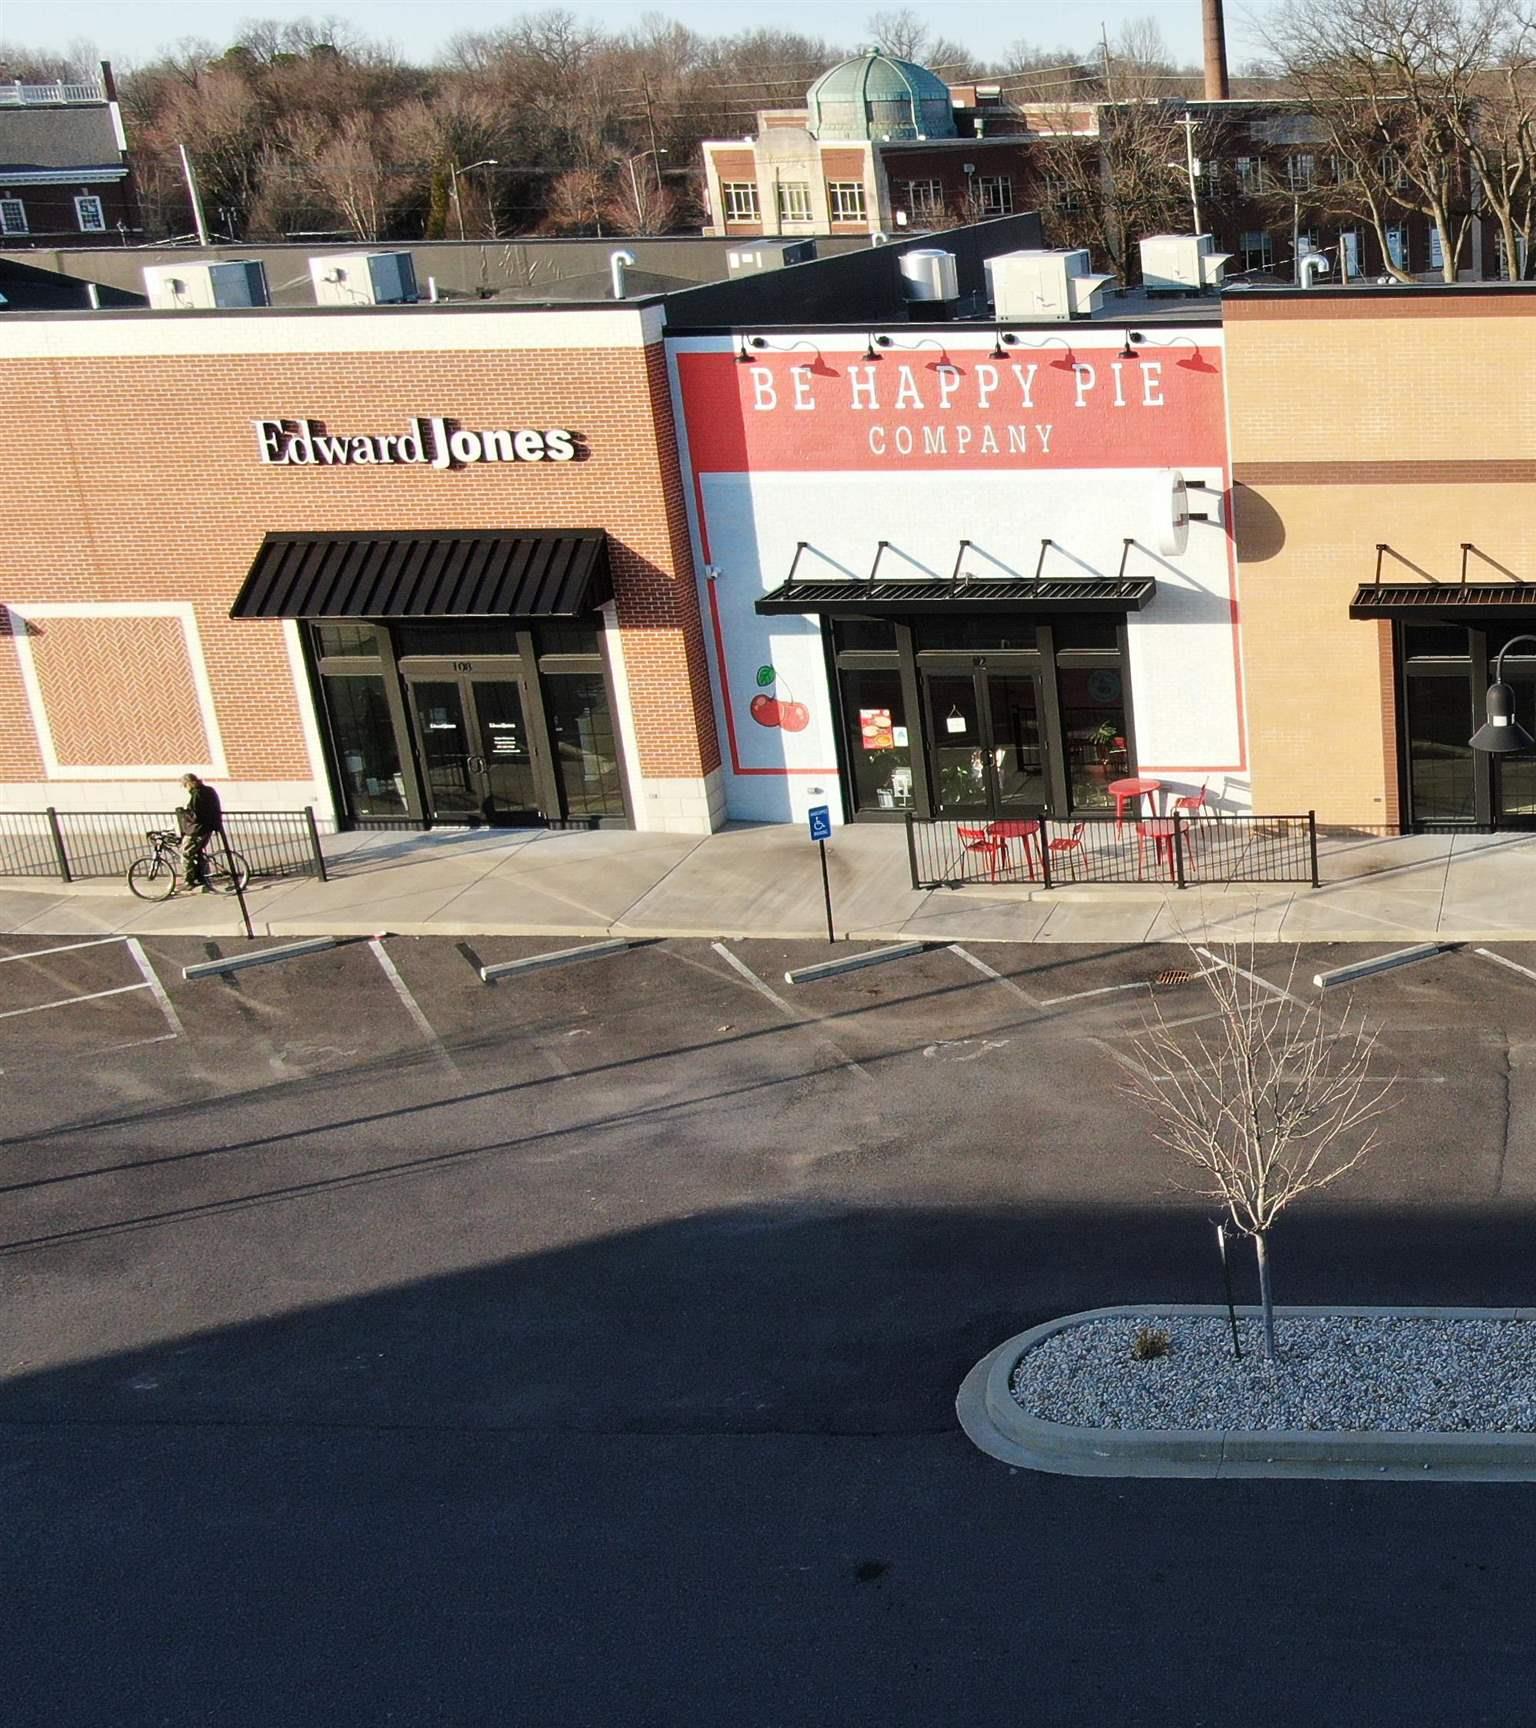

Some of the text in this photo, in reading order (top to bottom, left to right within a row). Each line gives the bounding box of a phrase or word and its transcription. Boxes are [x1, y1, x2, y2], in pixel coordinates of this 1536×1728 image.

[750, 362, 1165, 411] BE HAPPY PIE
[868, 424, 1054, 455] COMPANY
